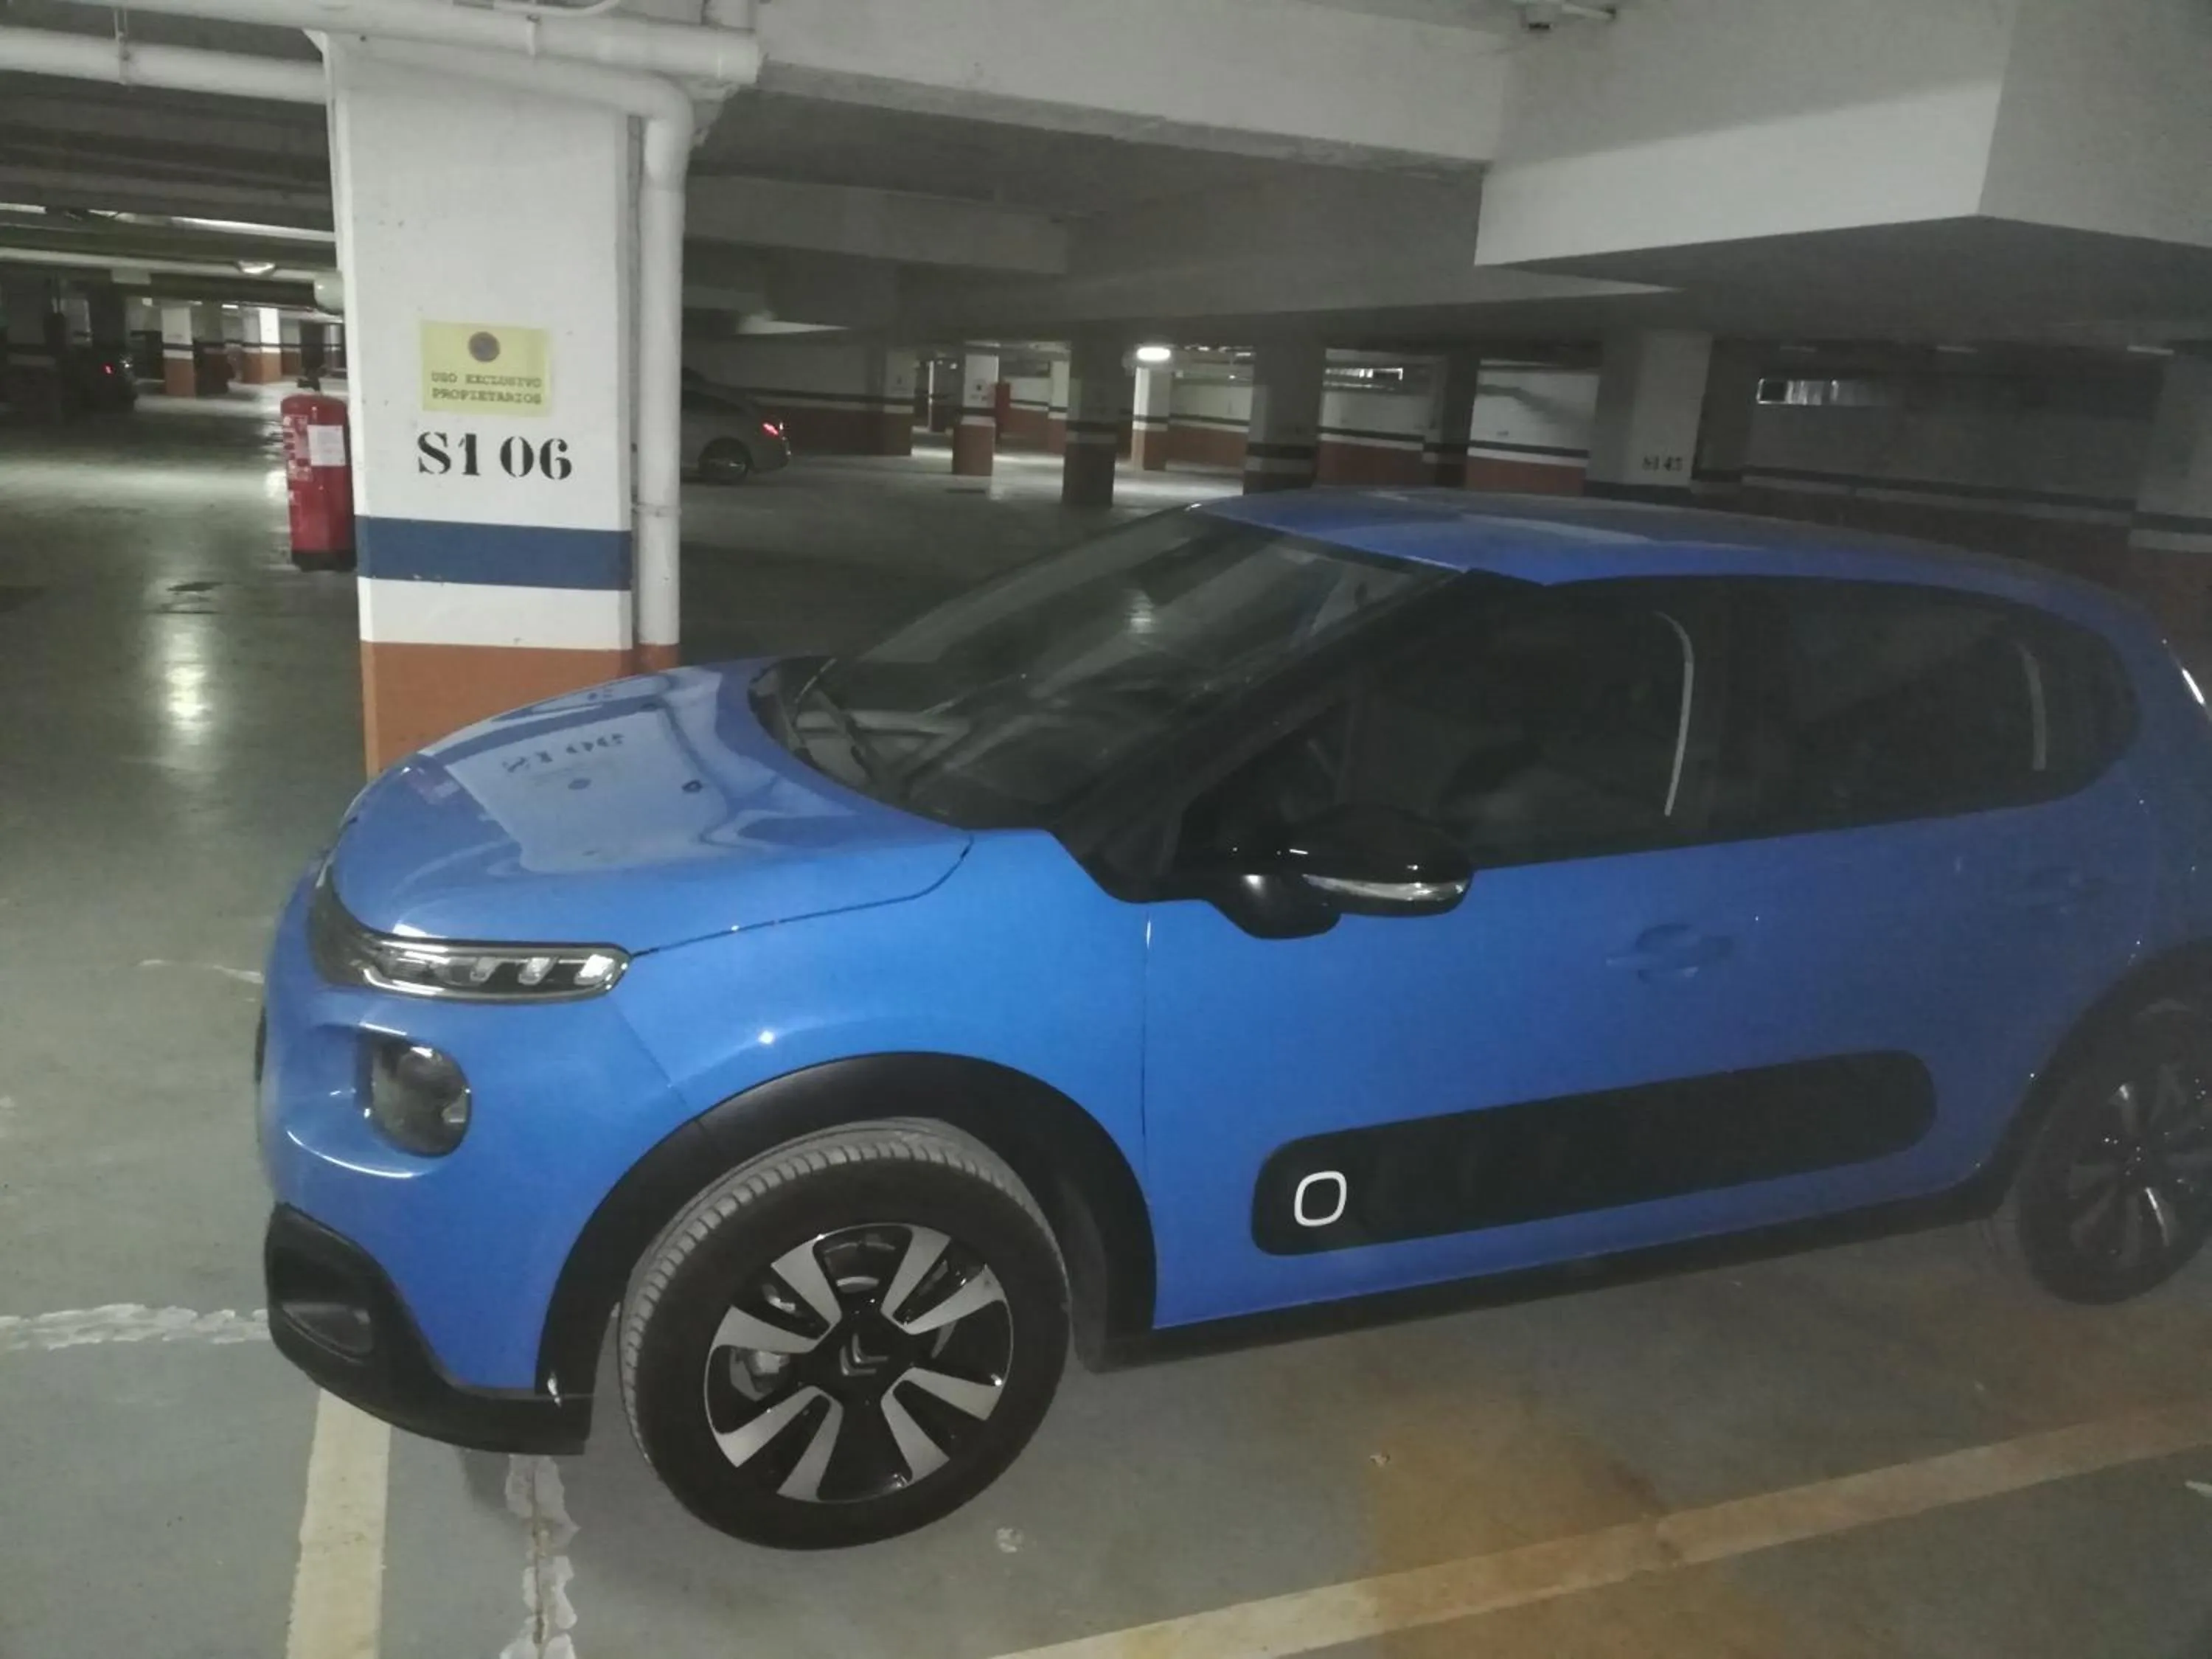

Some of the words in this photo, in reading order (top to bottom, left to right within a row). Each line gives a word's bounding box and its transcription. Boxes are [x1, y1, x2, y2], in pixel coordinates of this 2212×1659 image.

[431, 372, 458, 384] USO
[465, 374, 542, 389] EXCLUSIVO
[431, 387, 542, 405] PROPIETARIOS
